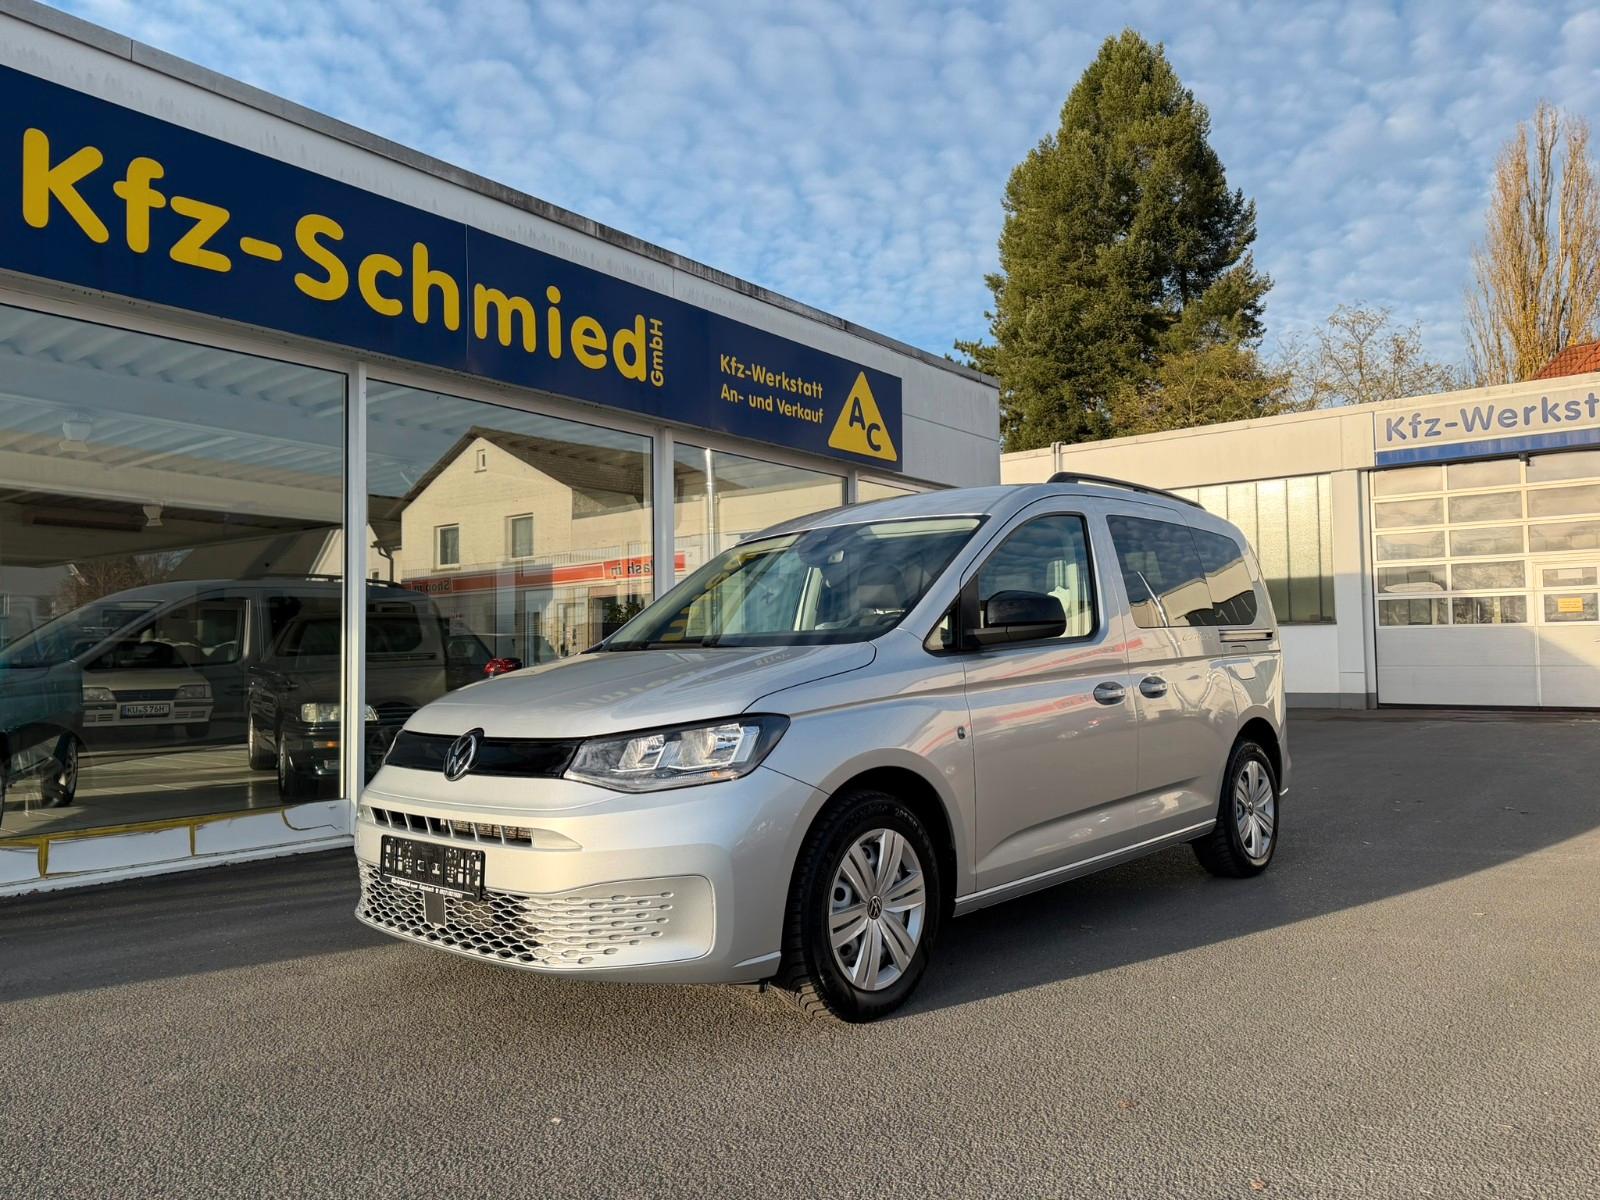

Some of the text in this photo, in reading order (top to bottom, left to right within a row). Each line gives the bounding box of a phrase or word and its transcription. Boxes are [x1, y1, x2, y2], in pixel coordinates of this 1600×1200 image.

[22, 128, 646, 383] Kfz-Schmied
[649, 318, 664, 387] GmbH
[720, 354, 823, 400] Kfz-Werkstatt
[721, 383, 824, 424] An- und Verkauf
